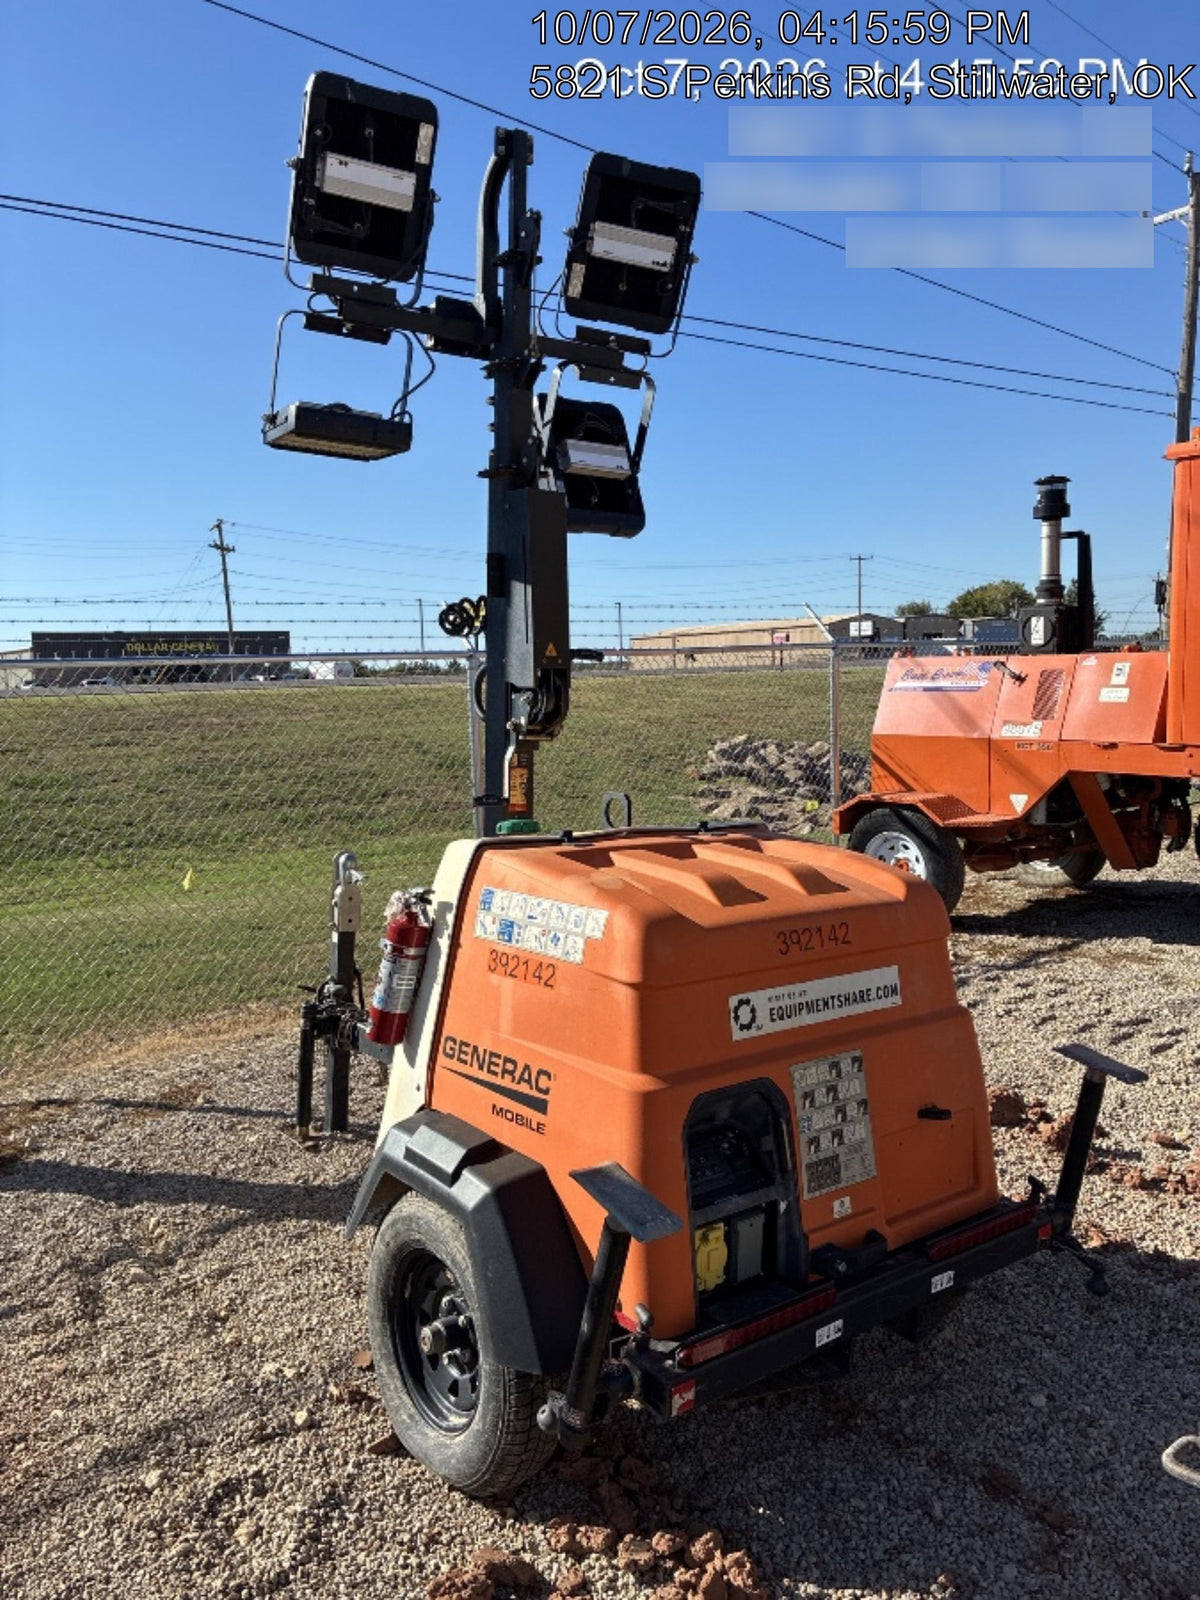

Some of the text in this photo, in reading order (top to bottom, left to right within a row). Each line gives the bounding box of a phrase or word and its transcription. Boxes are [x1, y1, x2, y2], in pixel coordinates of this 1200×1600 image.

[777, 922, 853, 955] 392142
[488, 949, 556, 989] 392142
[769, 983, 898, 1022] EQUIPMENTSHARE.COM
[442, 1036, 552, 1096] GENERAC
[491, 1103, 546, 1135] MOBILE
